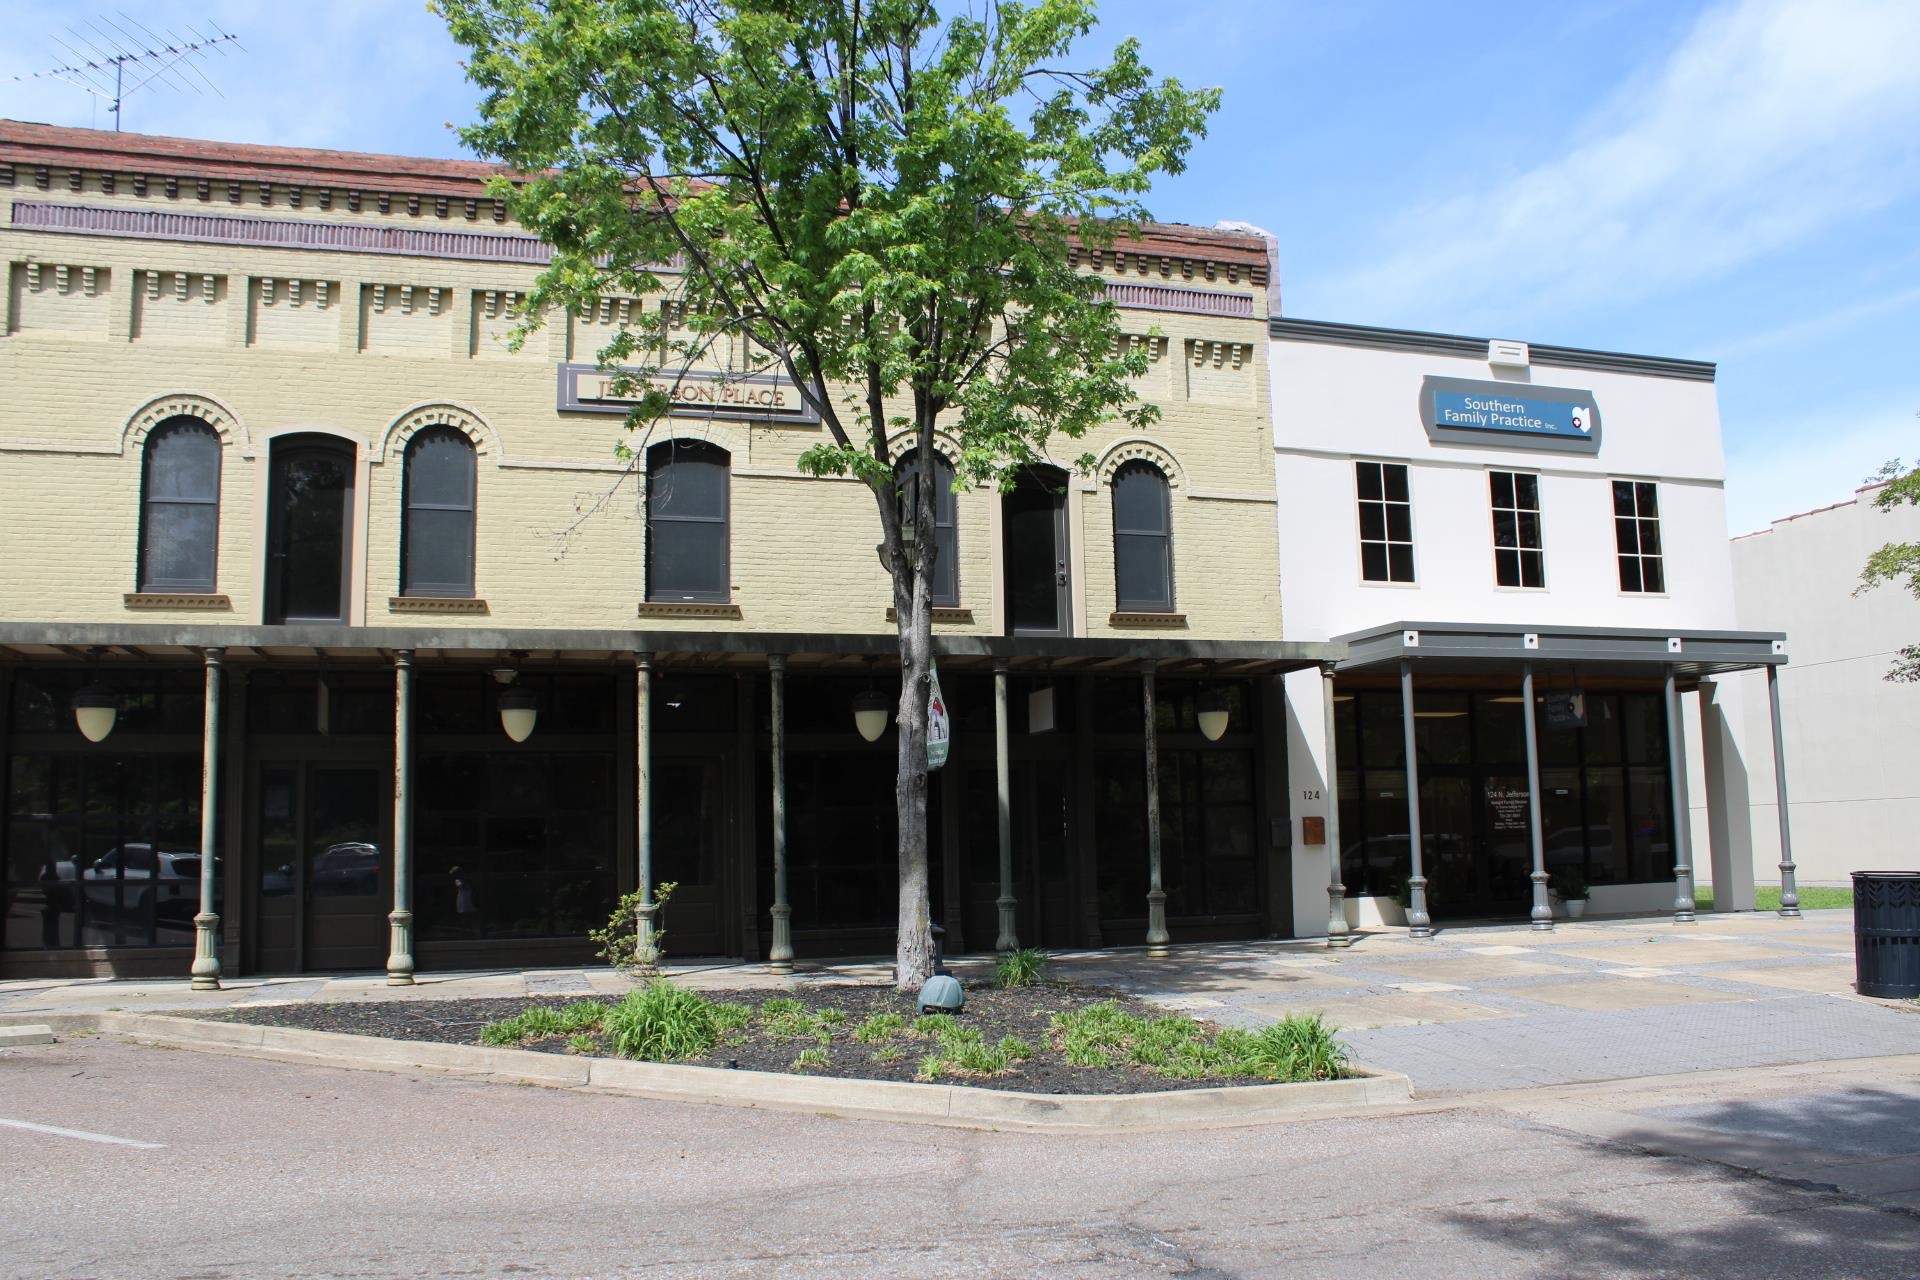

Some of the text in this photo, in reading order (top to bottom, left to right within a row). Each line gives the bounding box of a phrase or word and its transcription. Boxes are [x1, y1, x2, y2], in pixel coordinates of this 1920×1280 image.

[722, 385, 785, 407] PLACE
[1464, 397, 1524, 414] Southern
[1444, 409, 1487, 426] Family
[1491, 413, 1542, 429] Practice
[1303, 790, 1320, 800] 124
